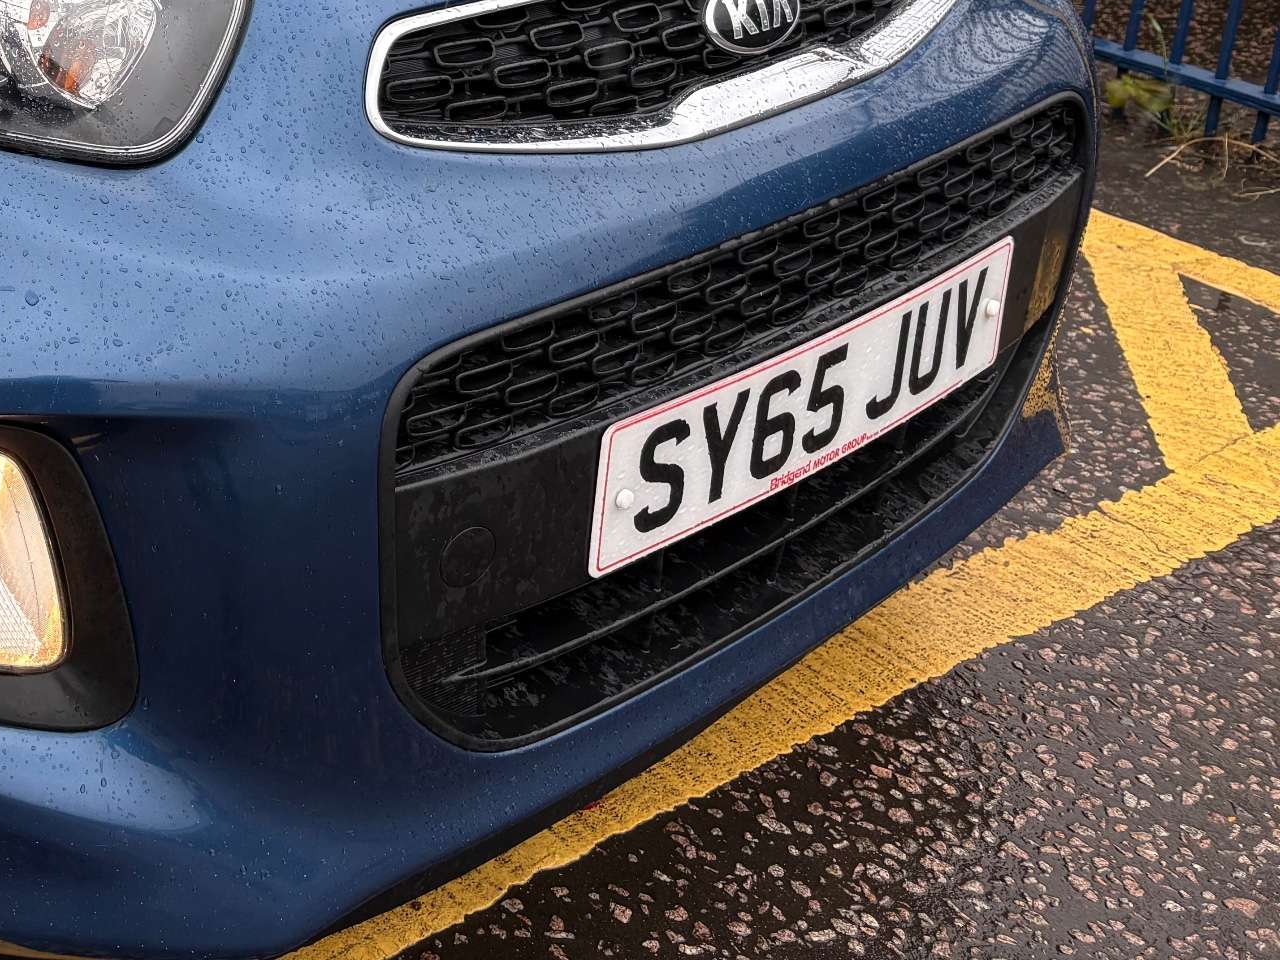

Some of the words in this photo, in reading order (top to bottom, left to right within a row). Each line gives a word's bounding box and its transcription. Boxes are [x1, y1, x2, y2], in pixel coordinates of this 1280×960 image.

[634, 343, 849, 534] SY65
[865, 266, 988, 420] JUV
[770, 457, 812, 491] Bridgend
[813, 448, 840, 468] MOTOR
